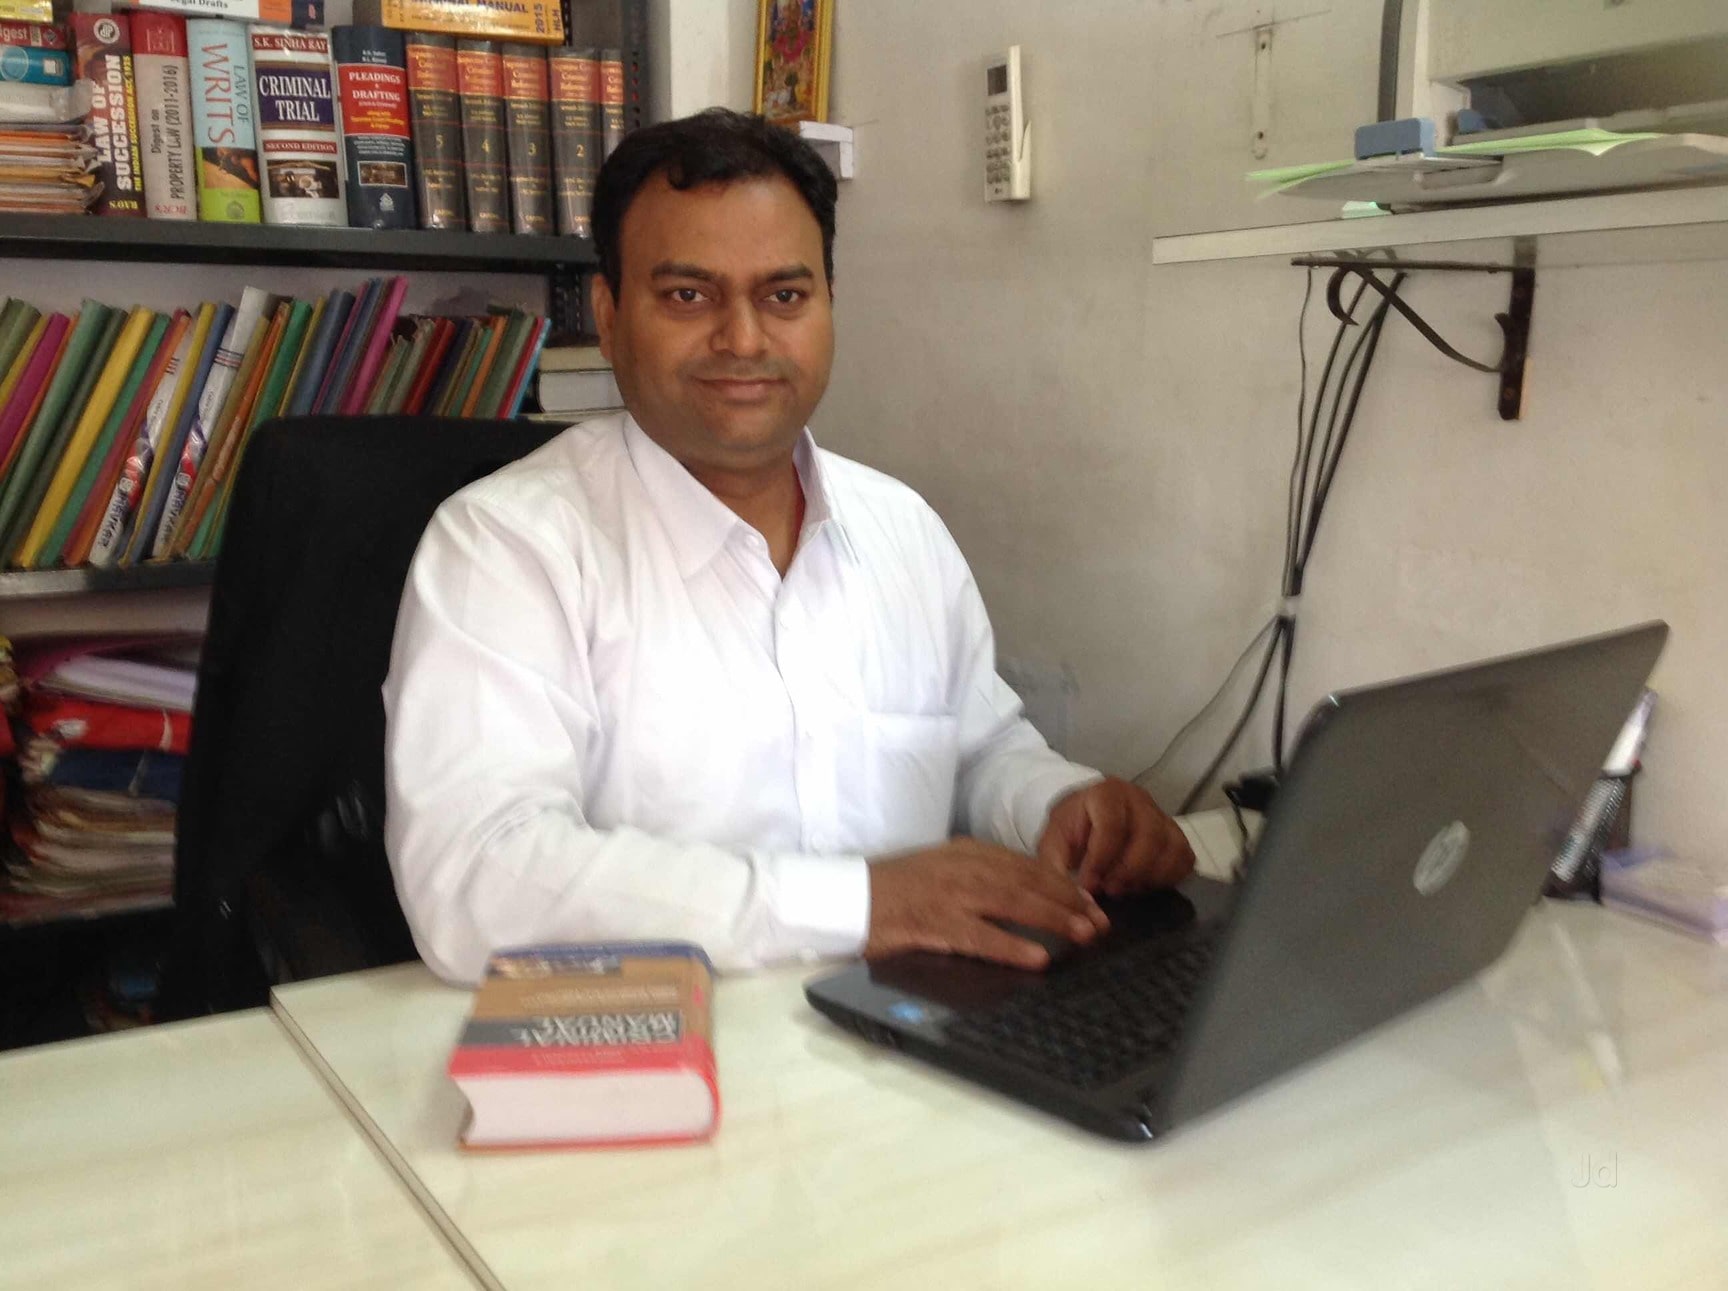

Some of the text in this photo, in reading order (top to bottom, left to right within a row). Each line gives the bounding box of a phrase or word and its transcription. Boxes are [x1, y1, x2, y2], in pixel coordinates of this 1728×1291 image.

[274, 38, 307, 49] SINHA
[308, 40, 327, 51] RAY
[259, 75, 331, 99] CRIMINAL
[348, 71, 401, 84] PLEADINGS
[162, 65, 182, 126] (2011-2016)
[202, 43, 236, 143] WRITS
[234, 65, 249, 122] LAW OF
[352, 90, 401, 102] DRAFTING
[104, 54, 133, 191] SUCCESSION
[275, 100, 320, 122] TRIAL
[93, 116, 113, 163] LAW
[151, 124, 164, 154] Digest
[265, 142, 336, 152] SECOND EDITION
[481, 138, 491, 152] 4
[528, 142, 537, 156] 3
[576, 144, 585, 157] 2
[167, 151, 184, 200] PROPERTY
